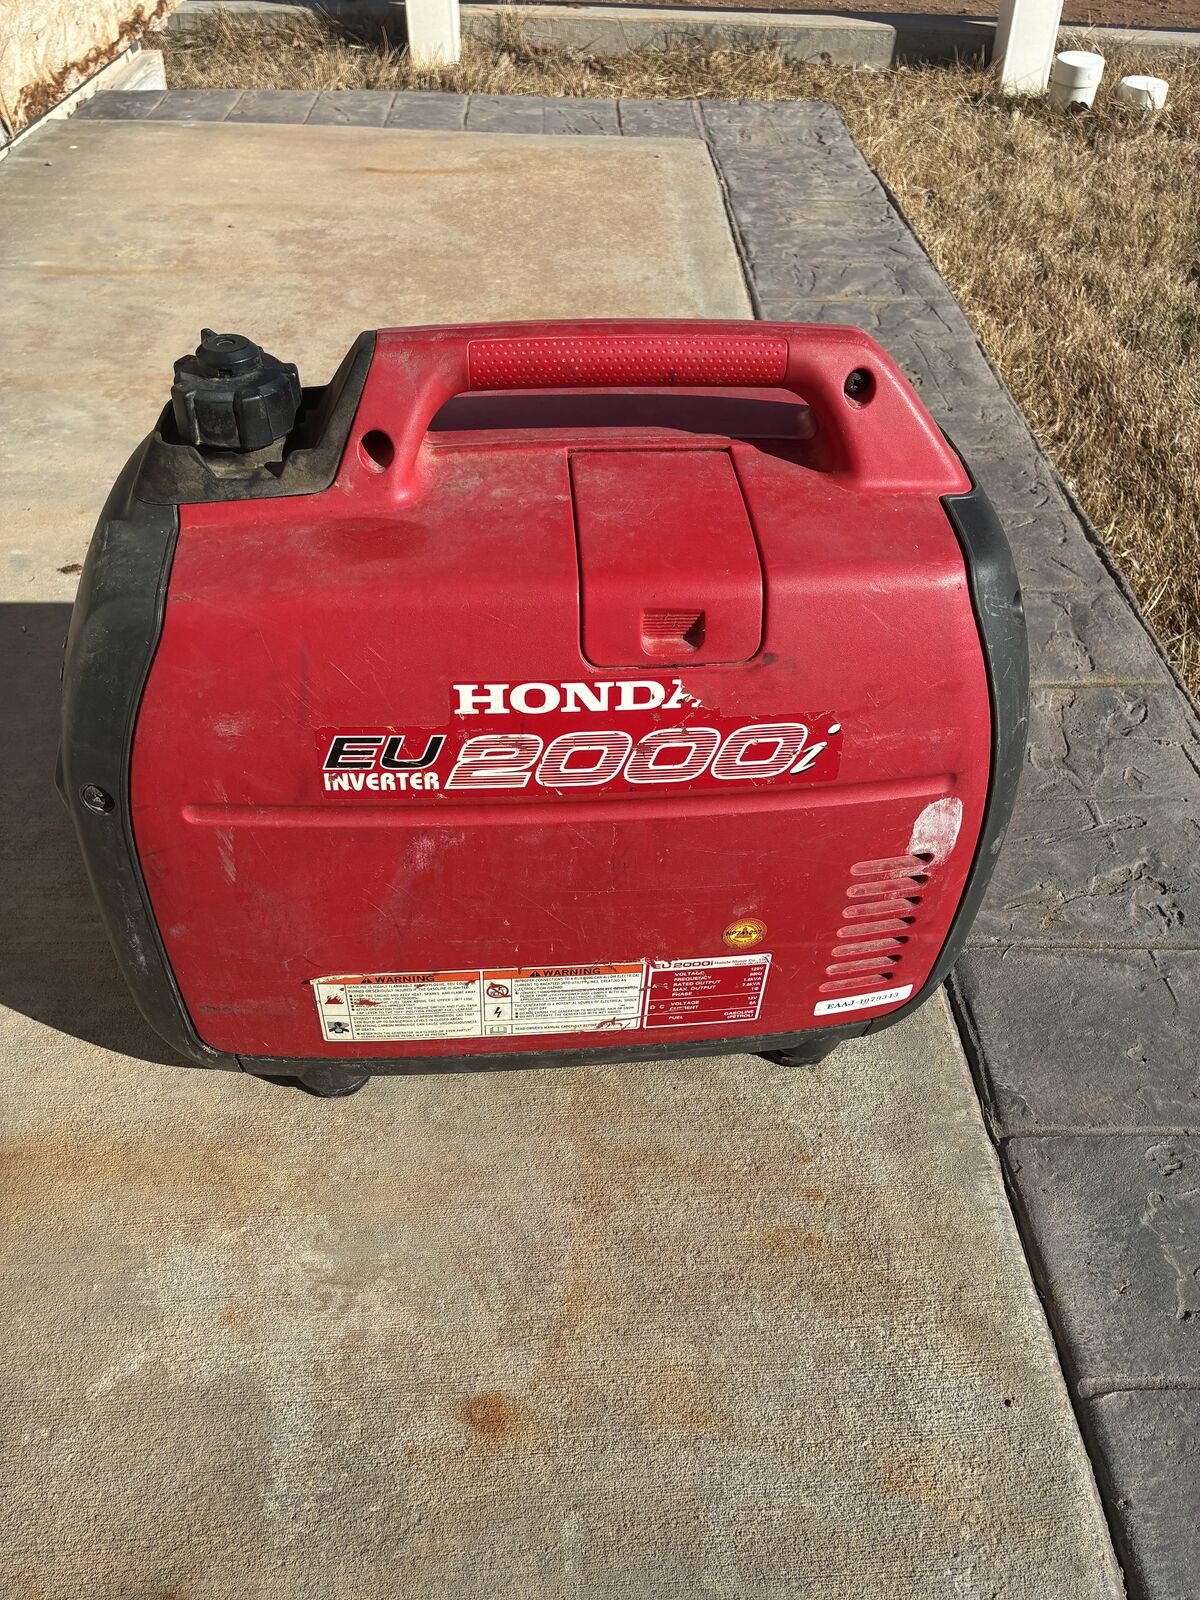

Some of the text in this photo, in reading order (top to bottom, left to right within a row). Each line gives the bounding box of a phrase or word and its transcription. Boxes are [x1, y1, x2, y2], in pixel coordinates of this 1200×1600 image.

[453, 679, 703, 714] HONDA
[322, 723, 841, 790] EU 2000i
[323, 771, 440, 791] INVERTER
[375, 975, 435, 983] WARNING
[543, 968, 600, 977] WARNING
